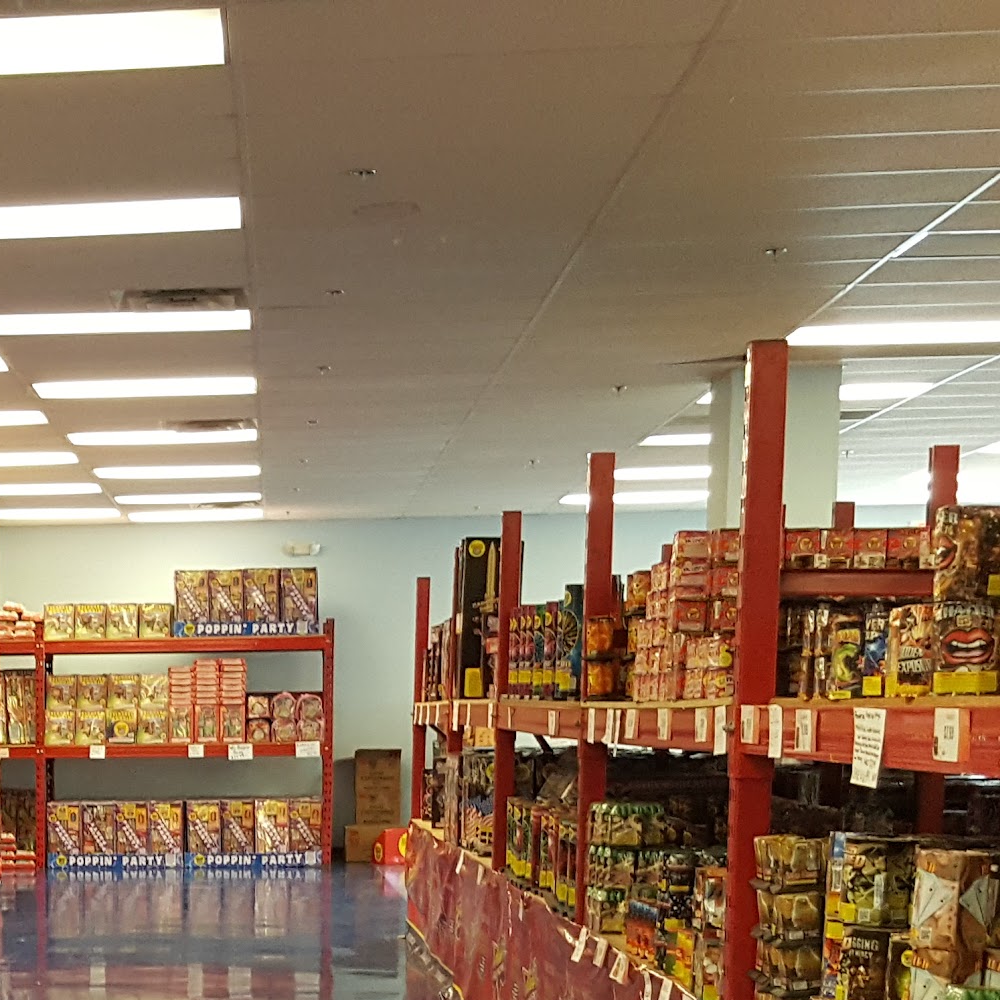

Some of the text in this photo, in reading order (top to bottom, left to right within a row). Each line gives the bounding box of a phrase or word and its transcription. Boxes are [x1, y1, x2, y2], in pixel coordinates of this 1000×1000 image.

[197, 621, 295, 635] POPPIN' PARTY
[69, 854, 163, 866] POPPIN' PARTY
[207, 854, 303, 866] POPPIN' PARTY
